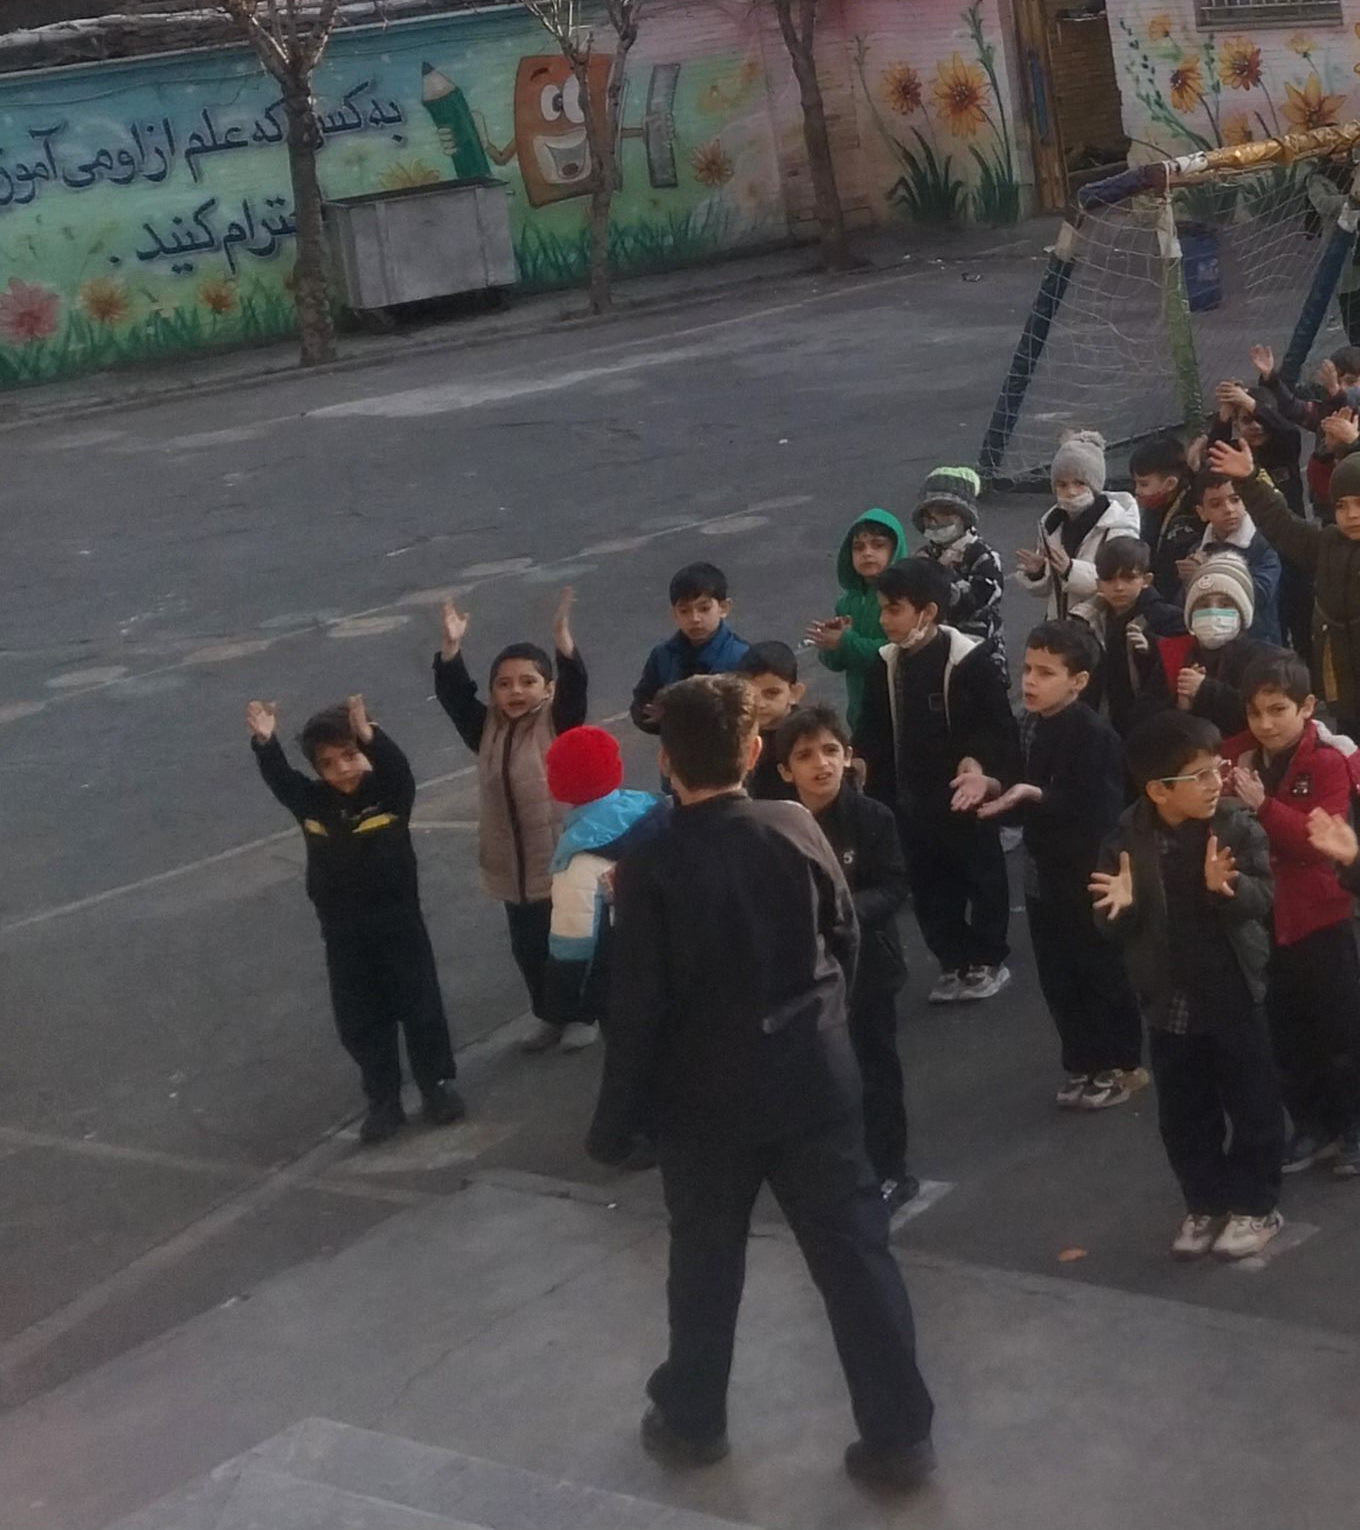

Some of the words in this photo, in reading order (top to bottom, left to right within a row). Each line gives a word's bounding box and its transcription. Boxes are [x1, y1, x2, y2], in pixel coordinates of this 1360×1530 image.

[185, 107, 248, 183] علم
[252, 97, 286, 143] که
[314, 80, 370, 150] کس
[368, 99, 403, 143] به
[0, 121, 65, 207] آموز
[62, 148, 114, 188] می
[109, 122, 146, 185] او
[142, 117, 175, 183] از
[223, 196, 297, 275] ترام
